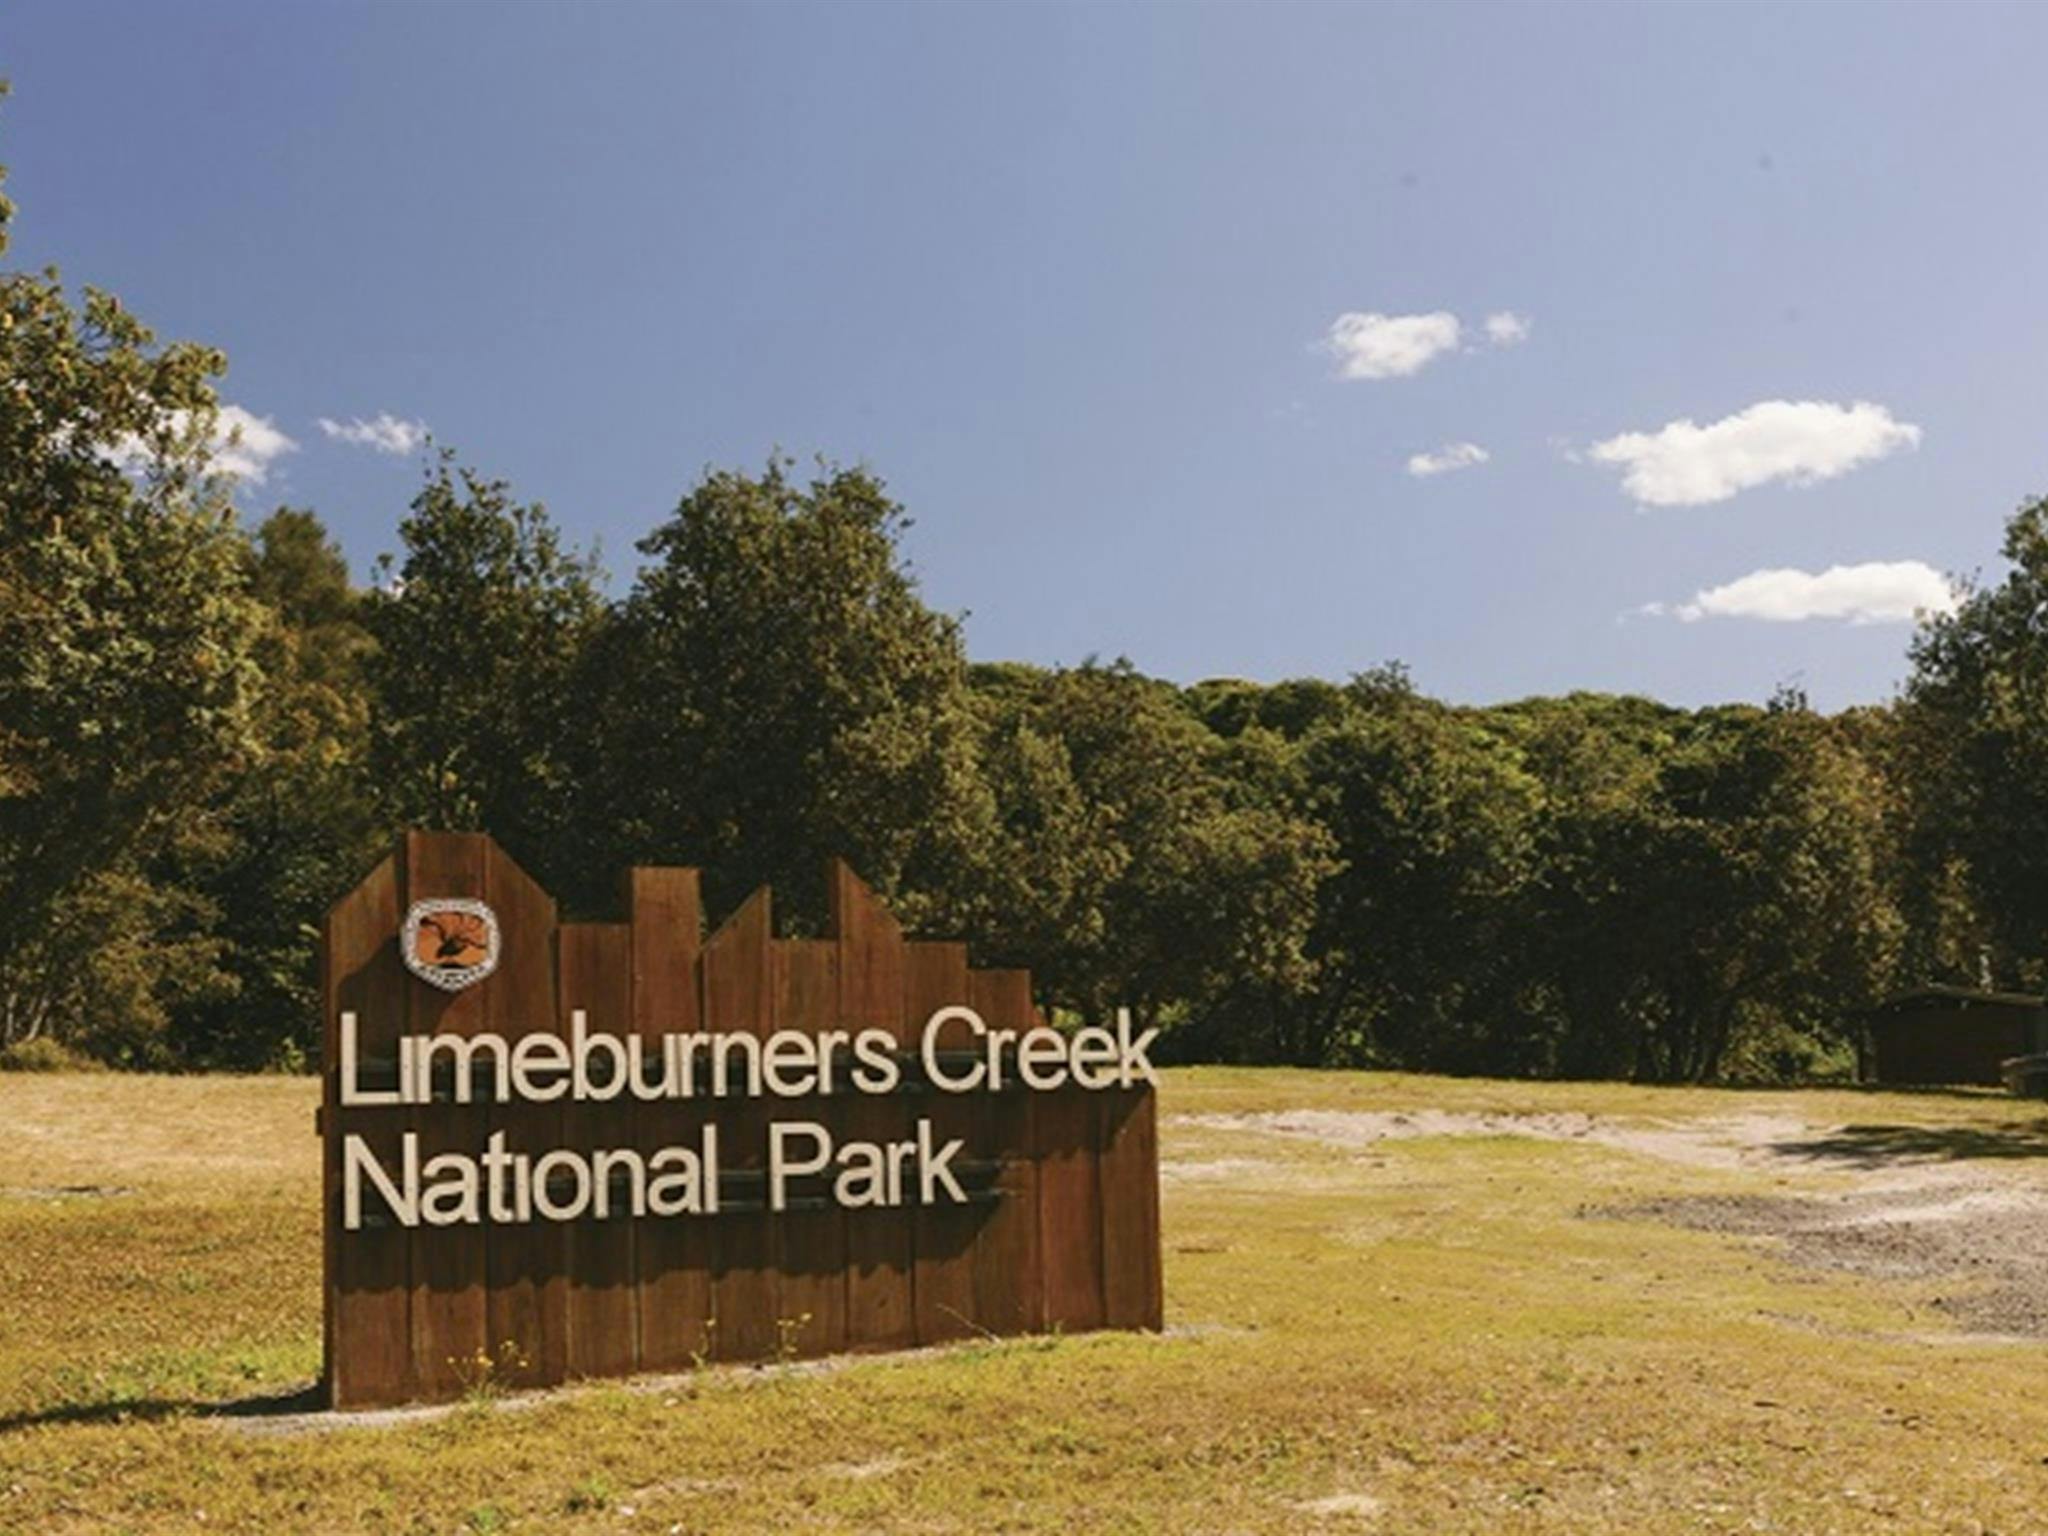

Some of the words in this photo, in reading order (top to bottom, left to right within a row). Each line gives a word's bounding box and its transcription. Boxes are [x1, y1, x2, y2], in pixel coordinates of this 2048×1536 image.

[340, 1009, 899, 1106] Limeburners
[922, 1006, 1160, 1092] Creek
[343, 1123, 718, 1230] National
[769, 1118, 968, 1211] Park
